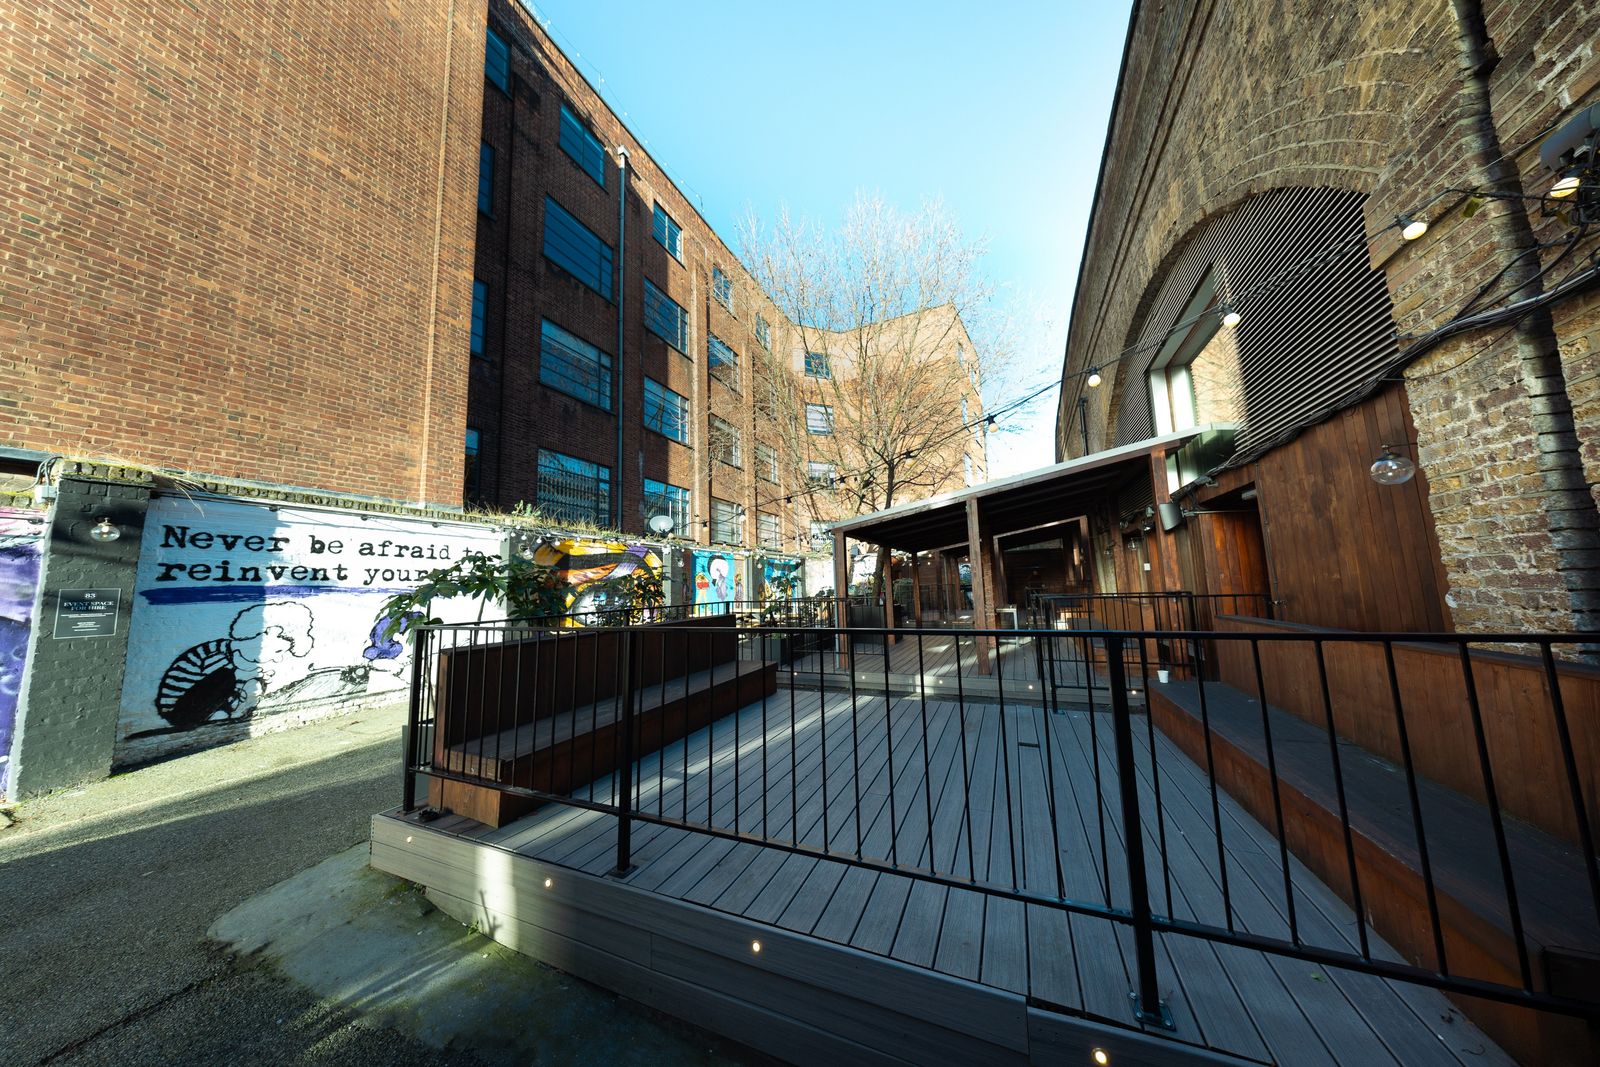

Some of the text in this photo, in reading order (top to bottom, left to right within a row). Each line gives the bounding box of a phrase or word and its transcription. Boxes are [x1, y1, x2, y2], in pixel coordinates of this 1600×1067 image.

[159, 524, 290, 552] Never
[308, 534, 344, 555] be
[358, 539, 451, 560] afraid
[155, 560, 348, 582] reinvent
